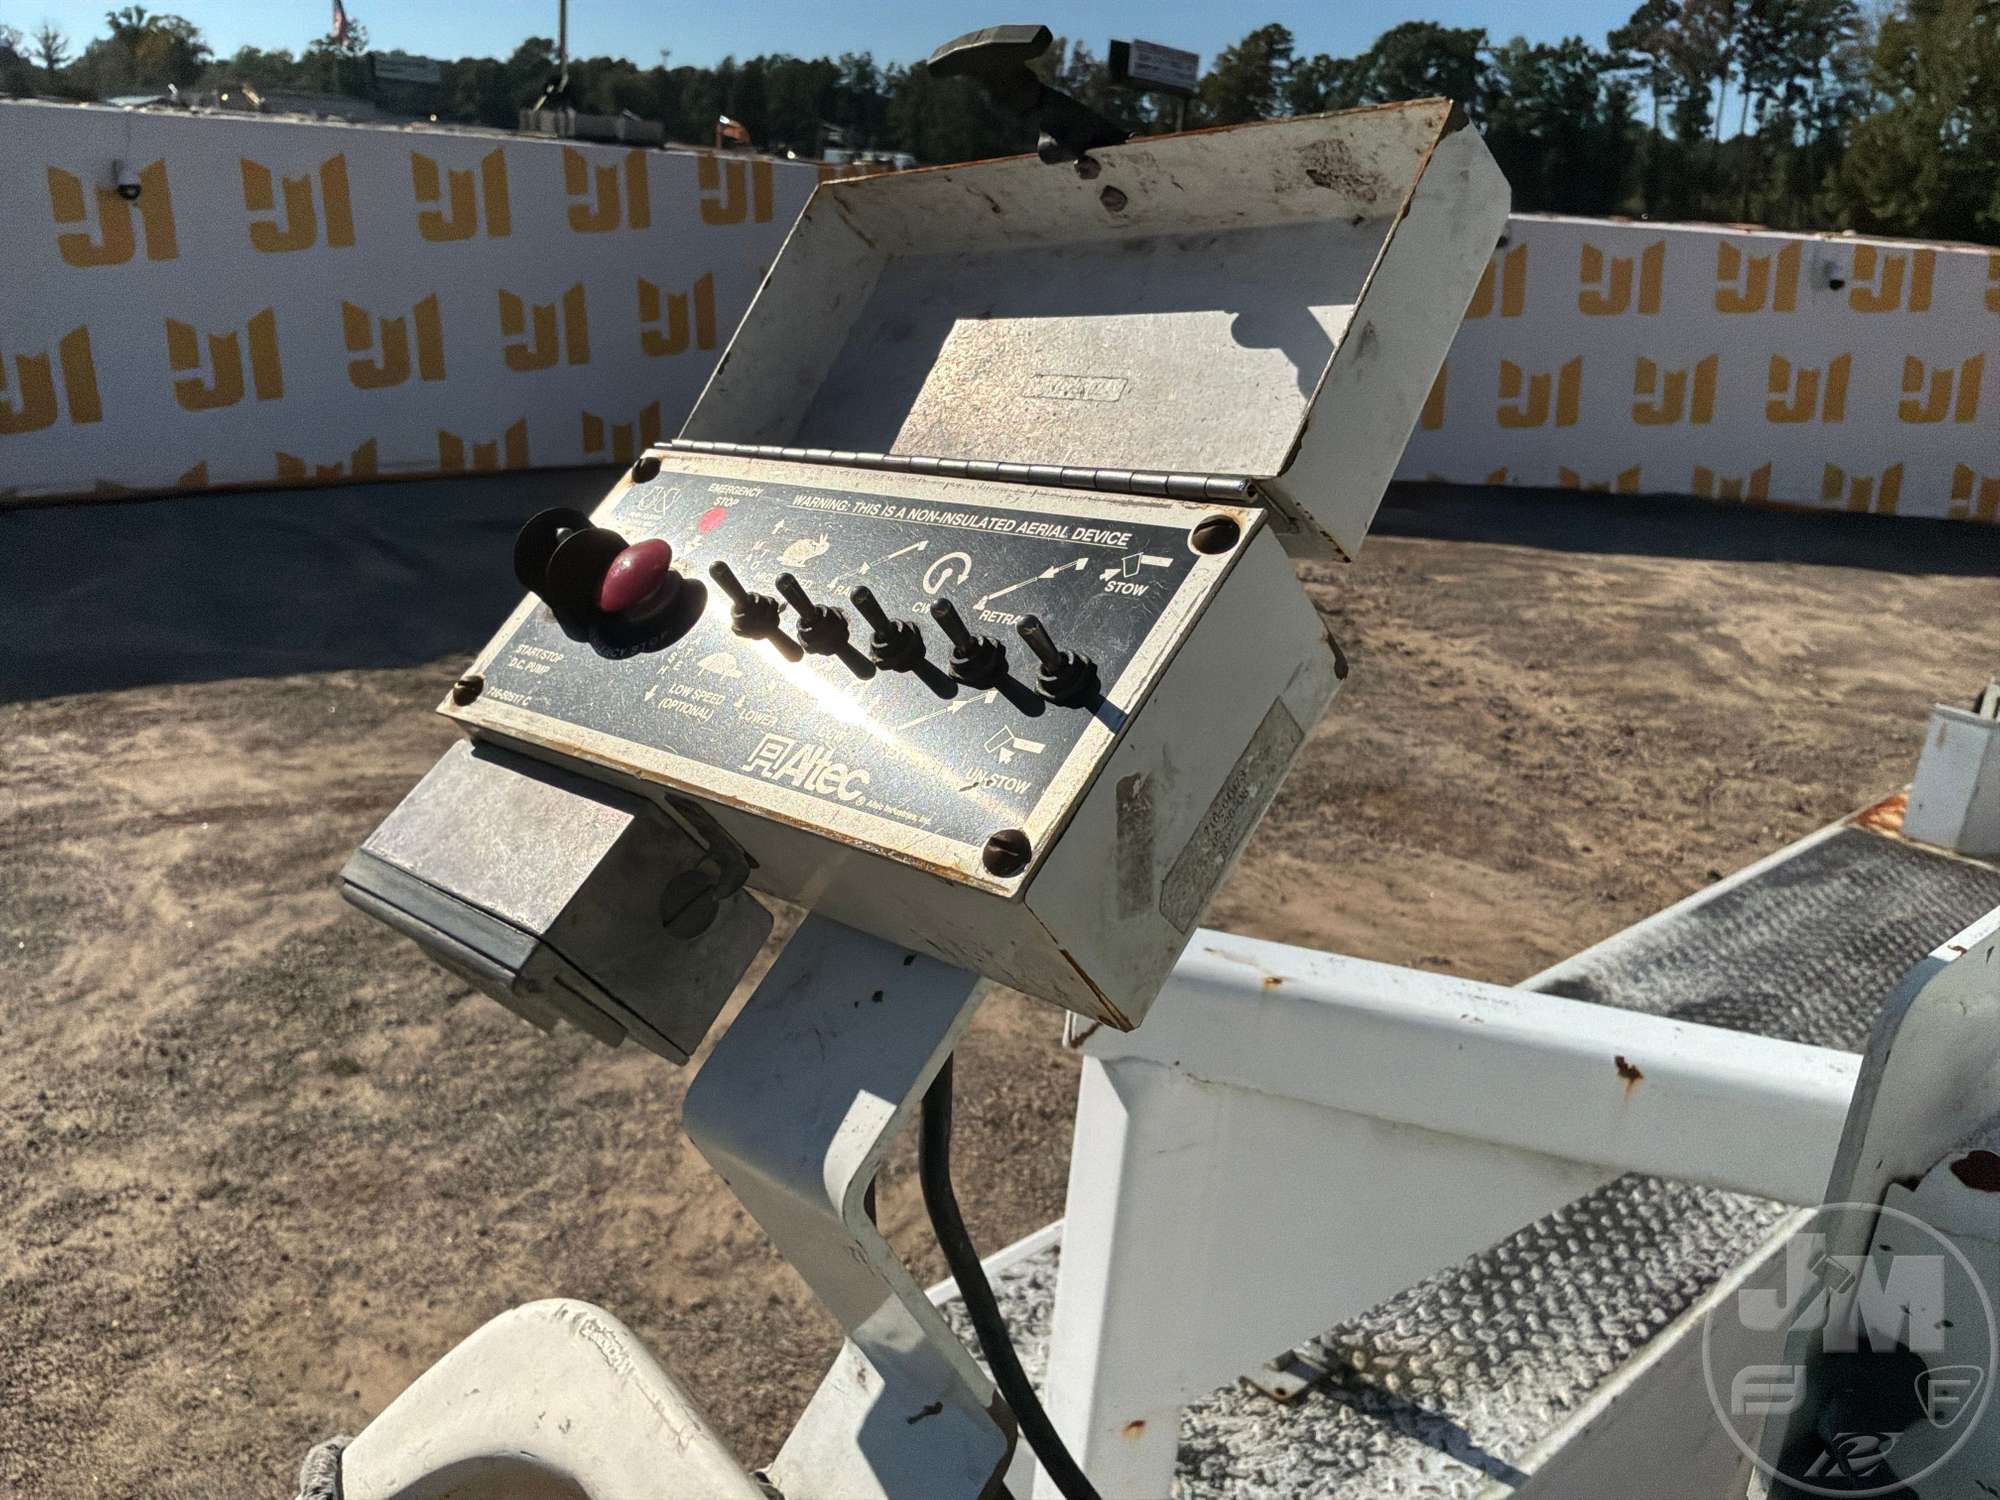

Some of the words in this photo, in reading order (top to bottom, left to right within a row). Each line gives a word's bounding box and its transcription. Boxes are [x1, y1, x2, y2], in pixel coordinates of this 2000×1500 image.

[706, 483, 763, 496] EMERGENCY
[712, 496, 739, 507] STOP
[791, 495, 852, 511] WARNING:
[851, 502, 882, 515] THIS
[879, 505, 898, 516] IS
[894, 507, 909, 518] A
[905, 509, 1018, 531] NON-INSULATED
[1014, 521, 1073, 538] AERIAL
[1069, 527, 1133, 545] DEVICE
[1102, 580, 1149, 596] STOW
[978, 610, 1023, 625] RETRA
[668, 684, 693, 697] LOW
[690, 689, 726, 705] SPEED
[656, 697, 715, 720] (OPTIONAL)
[738, 709, 778, 726] LOWER
[776, 744, 869, 801] Altec
[963, 769, 1031, 794] UN-STOW
